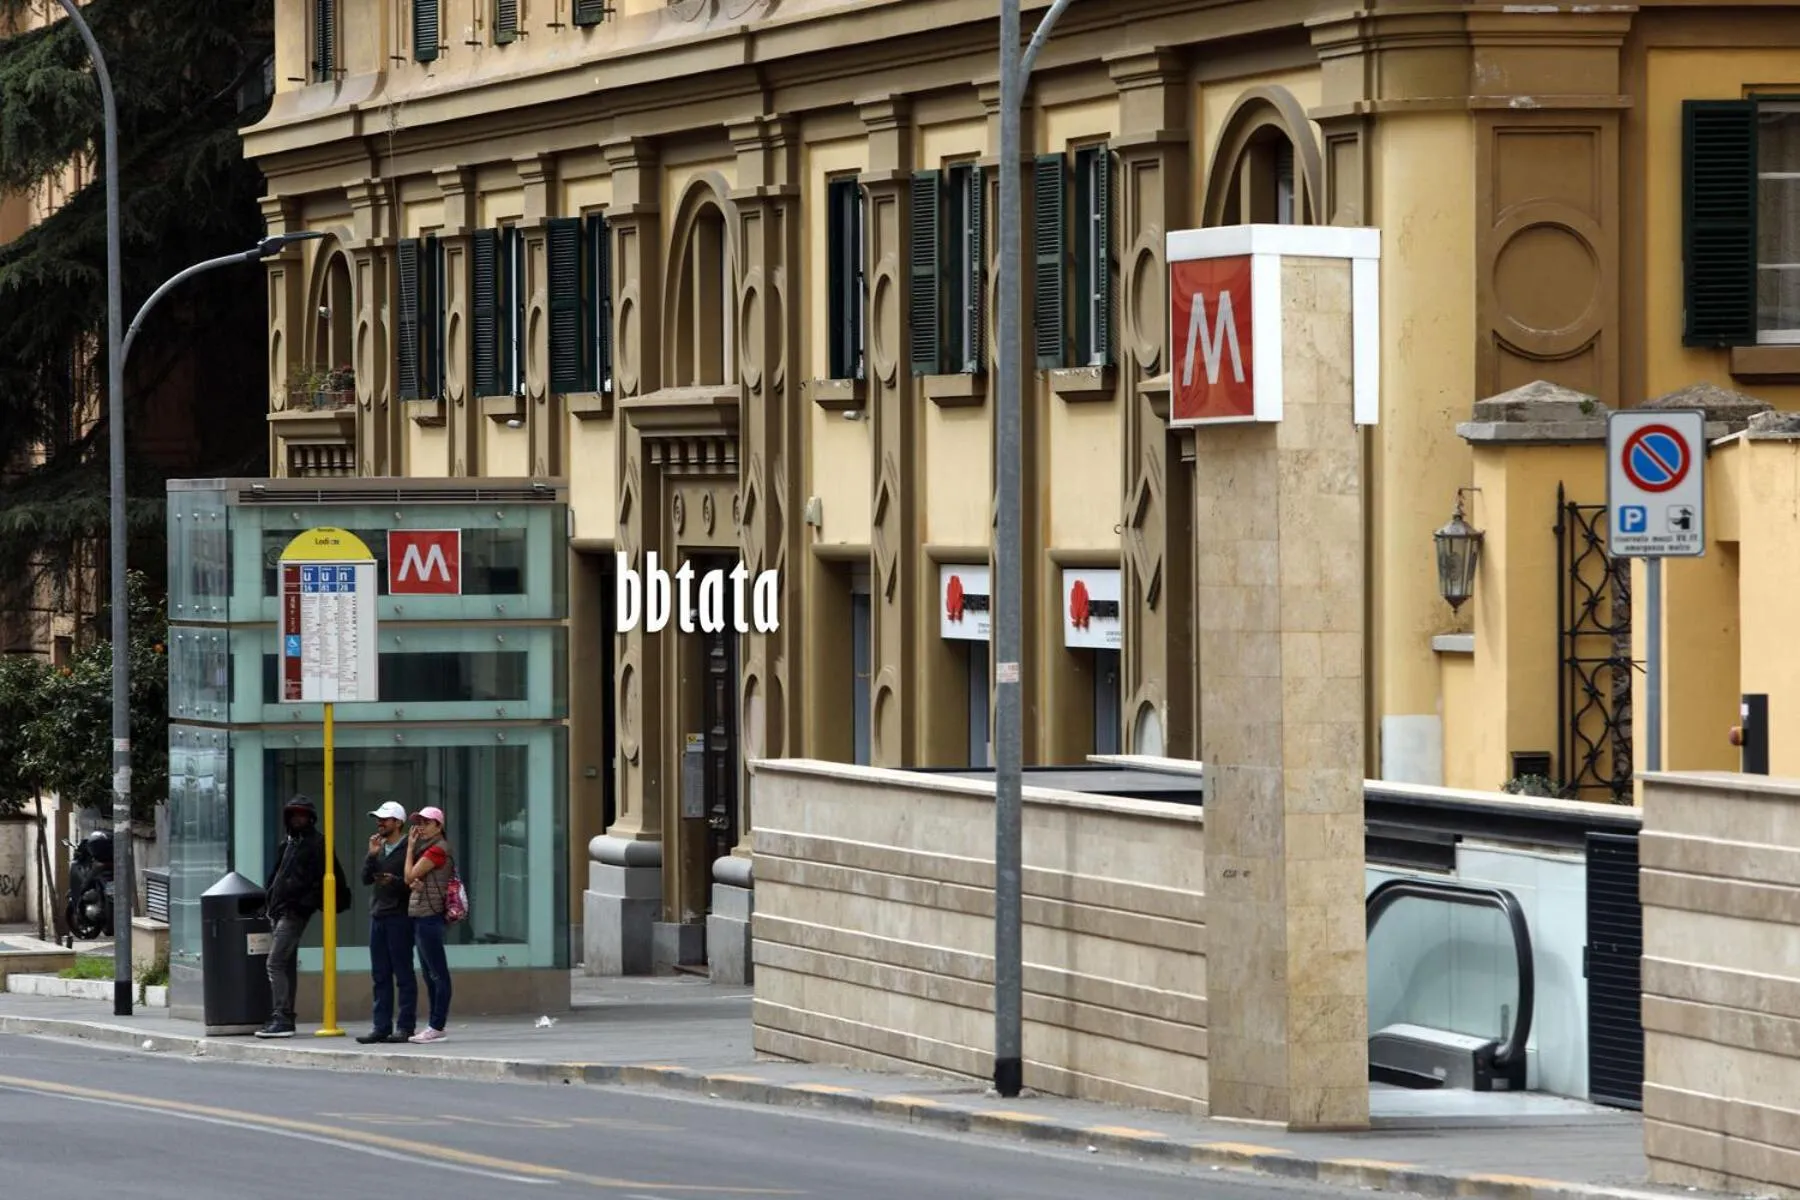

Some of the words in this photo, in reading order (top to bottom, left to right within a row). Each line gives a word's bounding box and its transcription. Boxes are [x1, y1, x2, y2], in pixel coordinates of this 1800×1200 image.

[1182, 290, 1245, 386] M
[1625, 509, 1643, 530] P
[397, 544, 451, 582] M
